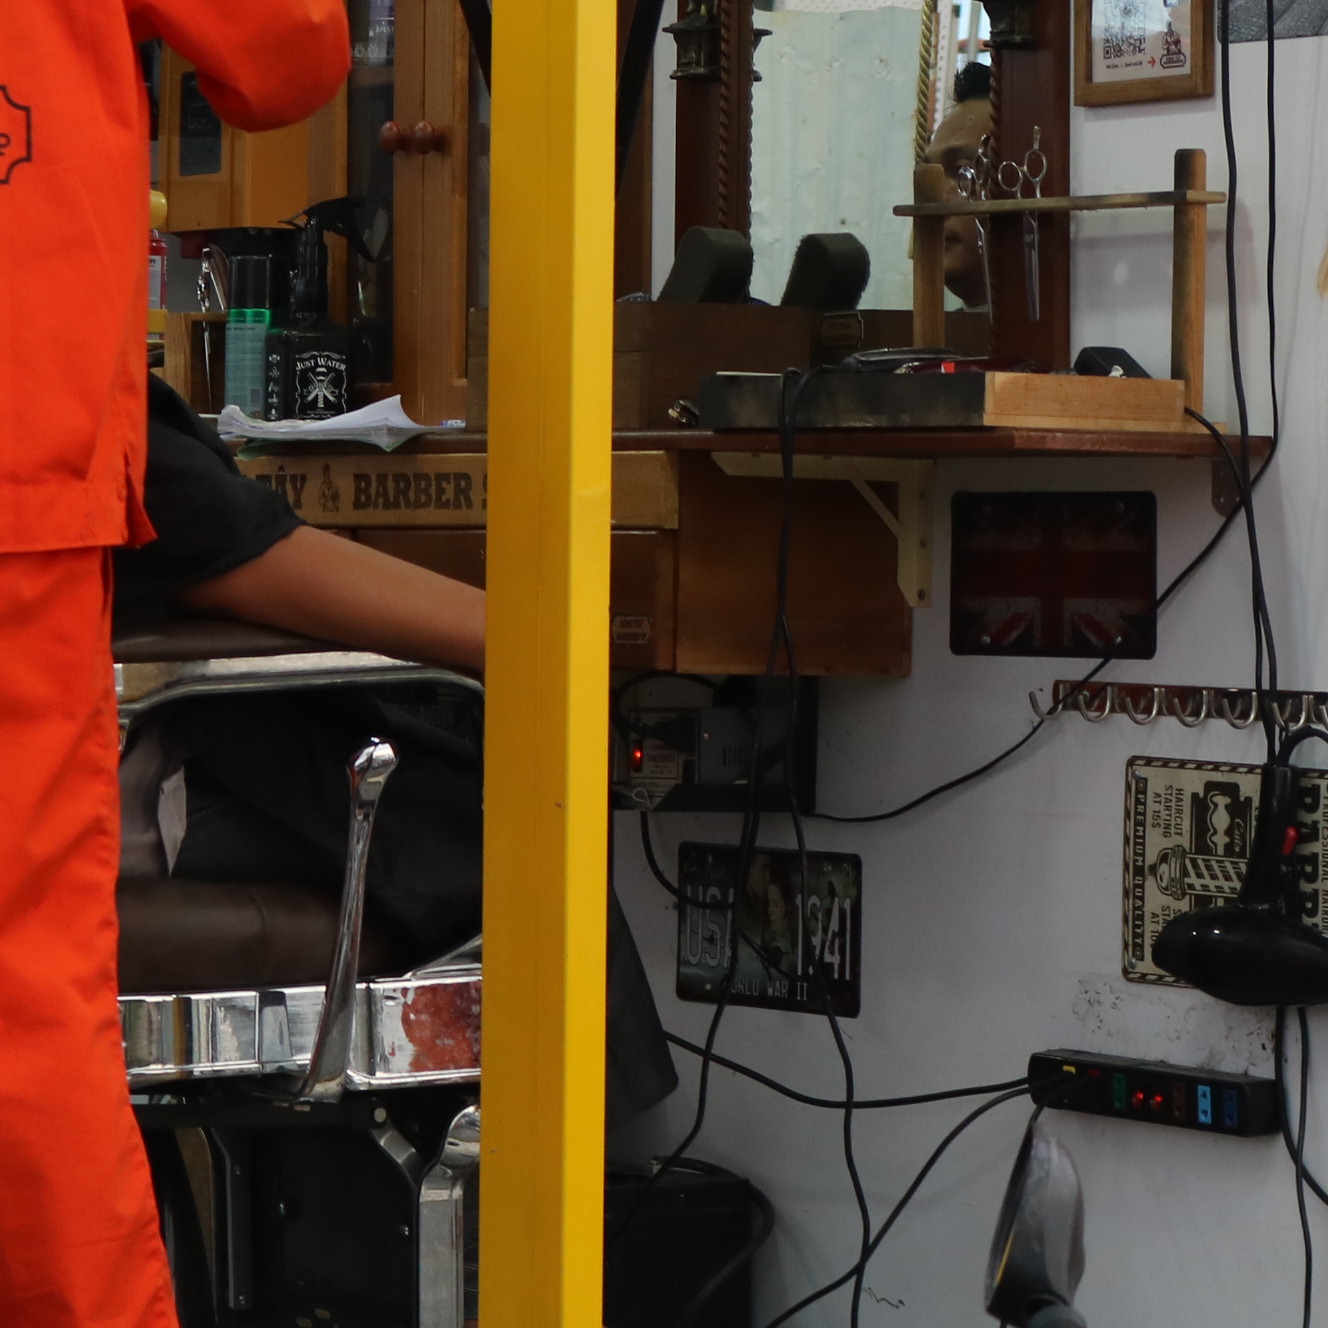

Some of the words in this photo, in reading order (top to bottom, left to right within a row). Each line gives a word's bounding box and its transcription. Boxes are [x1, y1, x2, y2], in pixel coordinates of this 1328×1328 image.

[296, 359, 316, 371] JUST
[317, 357, 347, 371] WATER
[352, 473, 474, 510] BARBER
[1152, 792, 1162, 806] AT
[1162, 784, 1173, 838] STARTING
[1173, 788, 1184, 837] HAIRCUT
[1134, 795, 1146, 867] PREMIUM
[1132, 876, 1144, 946] QUALITY
[729, 975, 760, 995] ORLD
